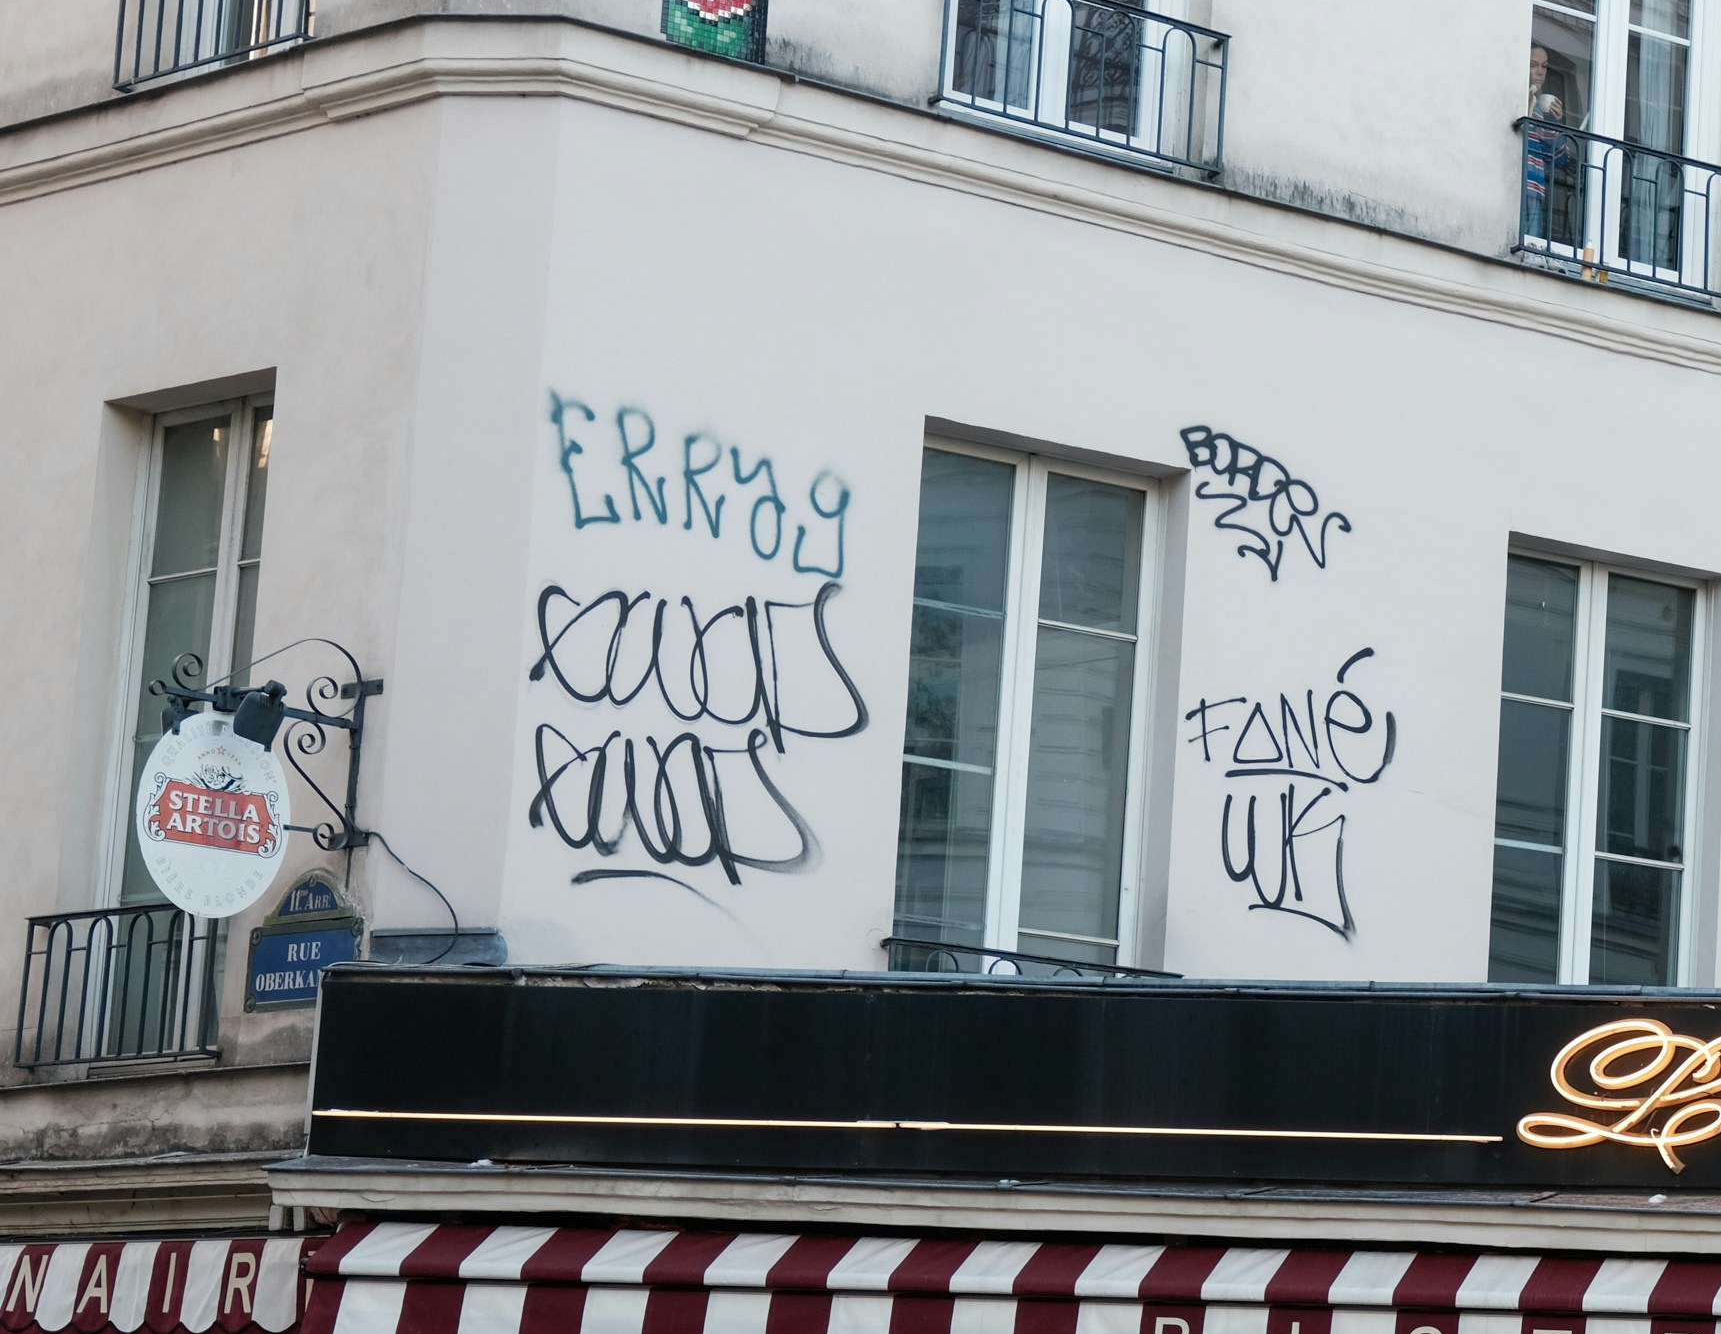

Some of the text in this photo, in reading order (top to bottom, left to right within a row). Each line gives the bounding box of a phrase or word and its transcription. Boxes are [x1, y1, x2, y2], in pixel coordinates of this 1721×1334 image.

[168, 789, 260, 824] STELLA
[166, 812, 260, 845] ARTOIS
[287, 941, 321, 962] RUE
[5, 1249, 315, 1318] NAIR
